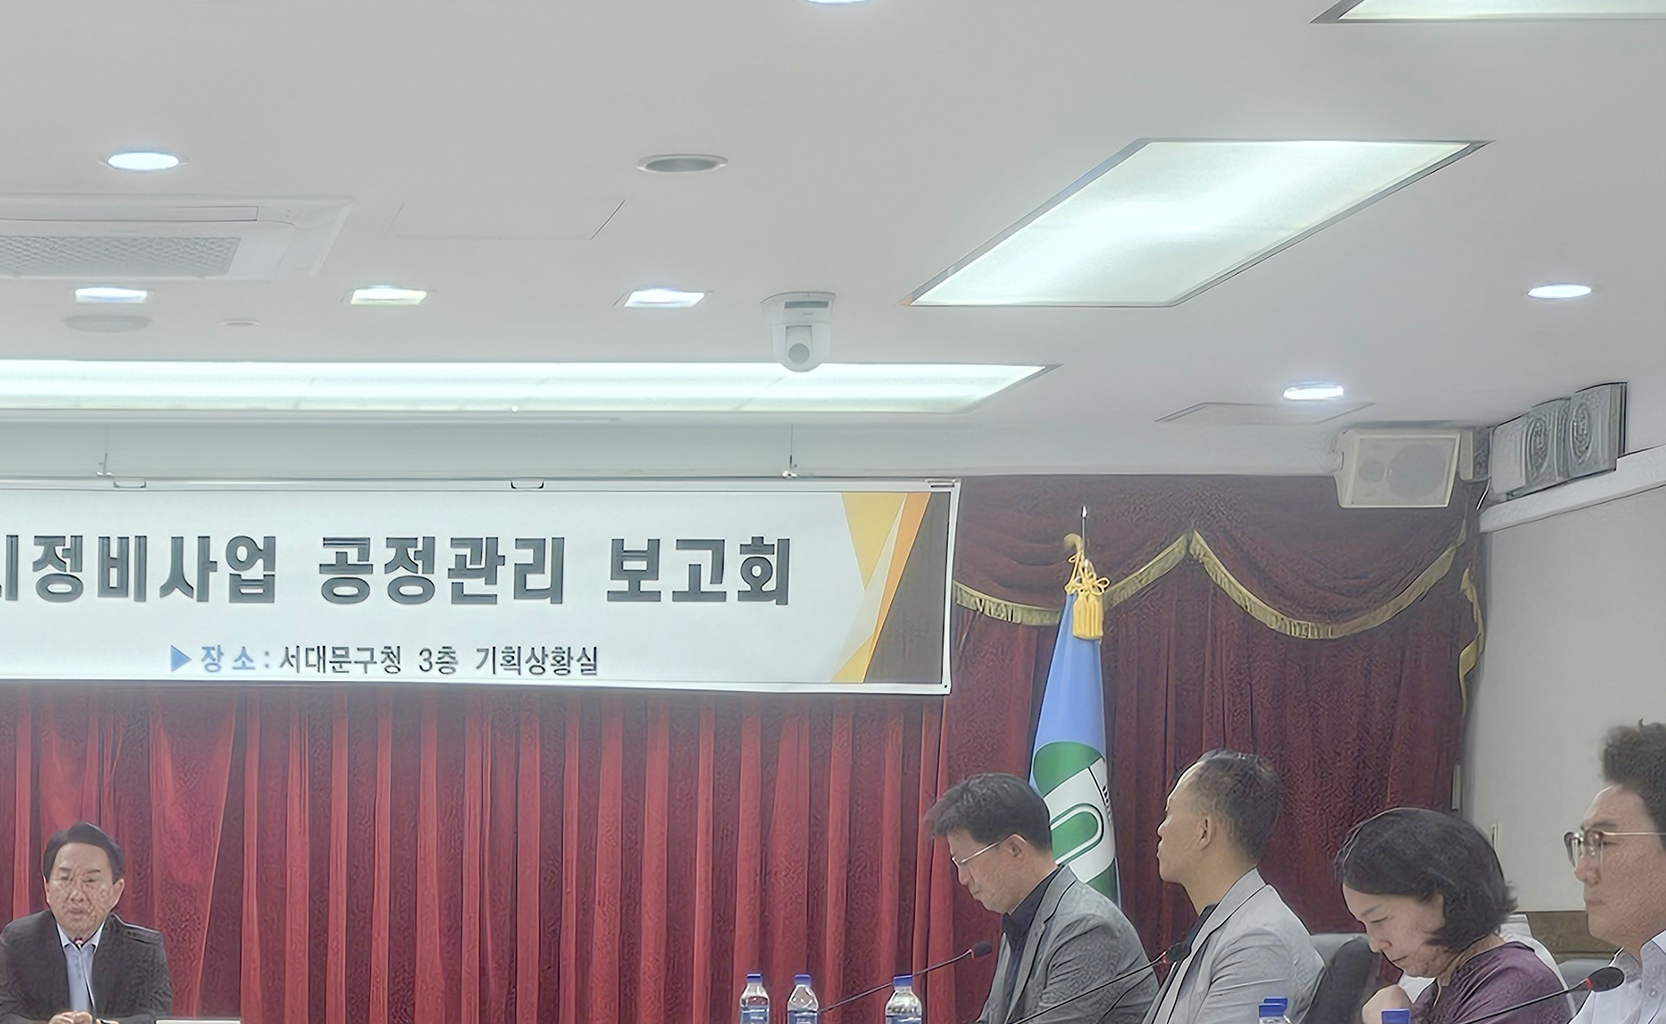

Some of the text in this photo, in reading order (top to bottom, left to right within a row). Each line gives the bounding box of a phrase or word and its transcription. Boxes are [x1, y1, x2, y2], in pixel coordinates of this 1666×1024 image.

[319, 536, 565, 605] 공정관리
[607, 536, 790, 606] 보고회
[280, 645, 402, 675] 서대문구청
[419, 646, 459, 676] 3층
[476, 646, 598, 676] 기획상황실
